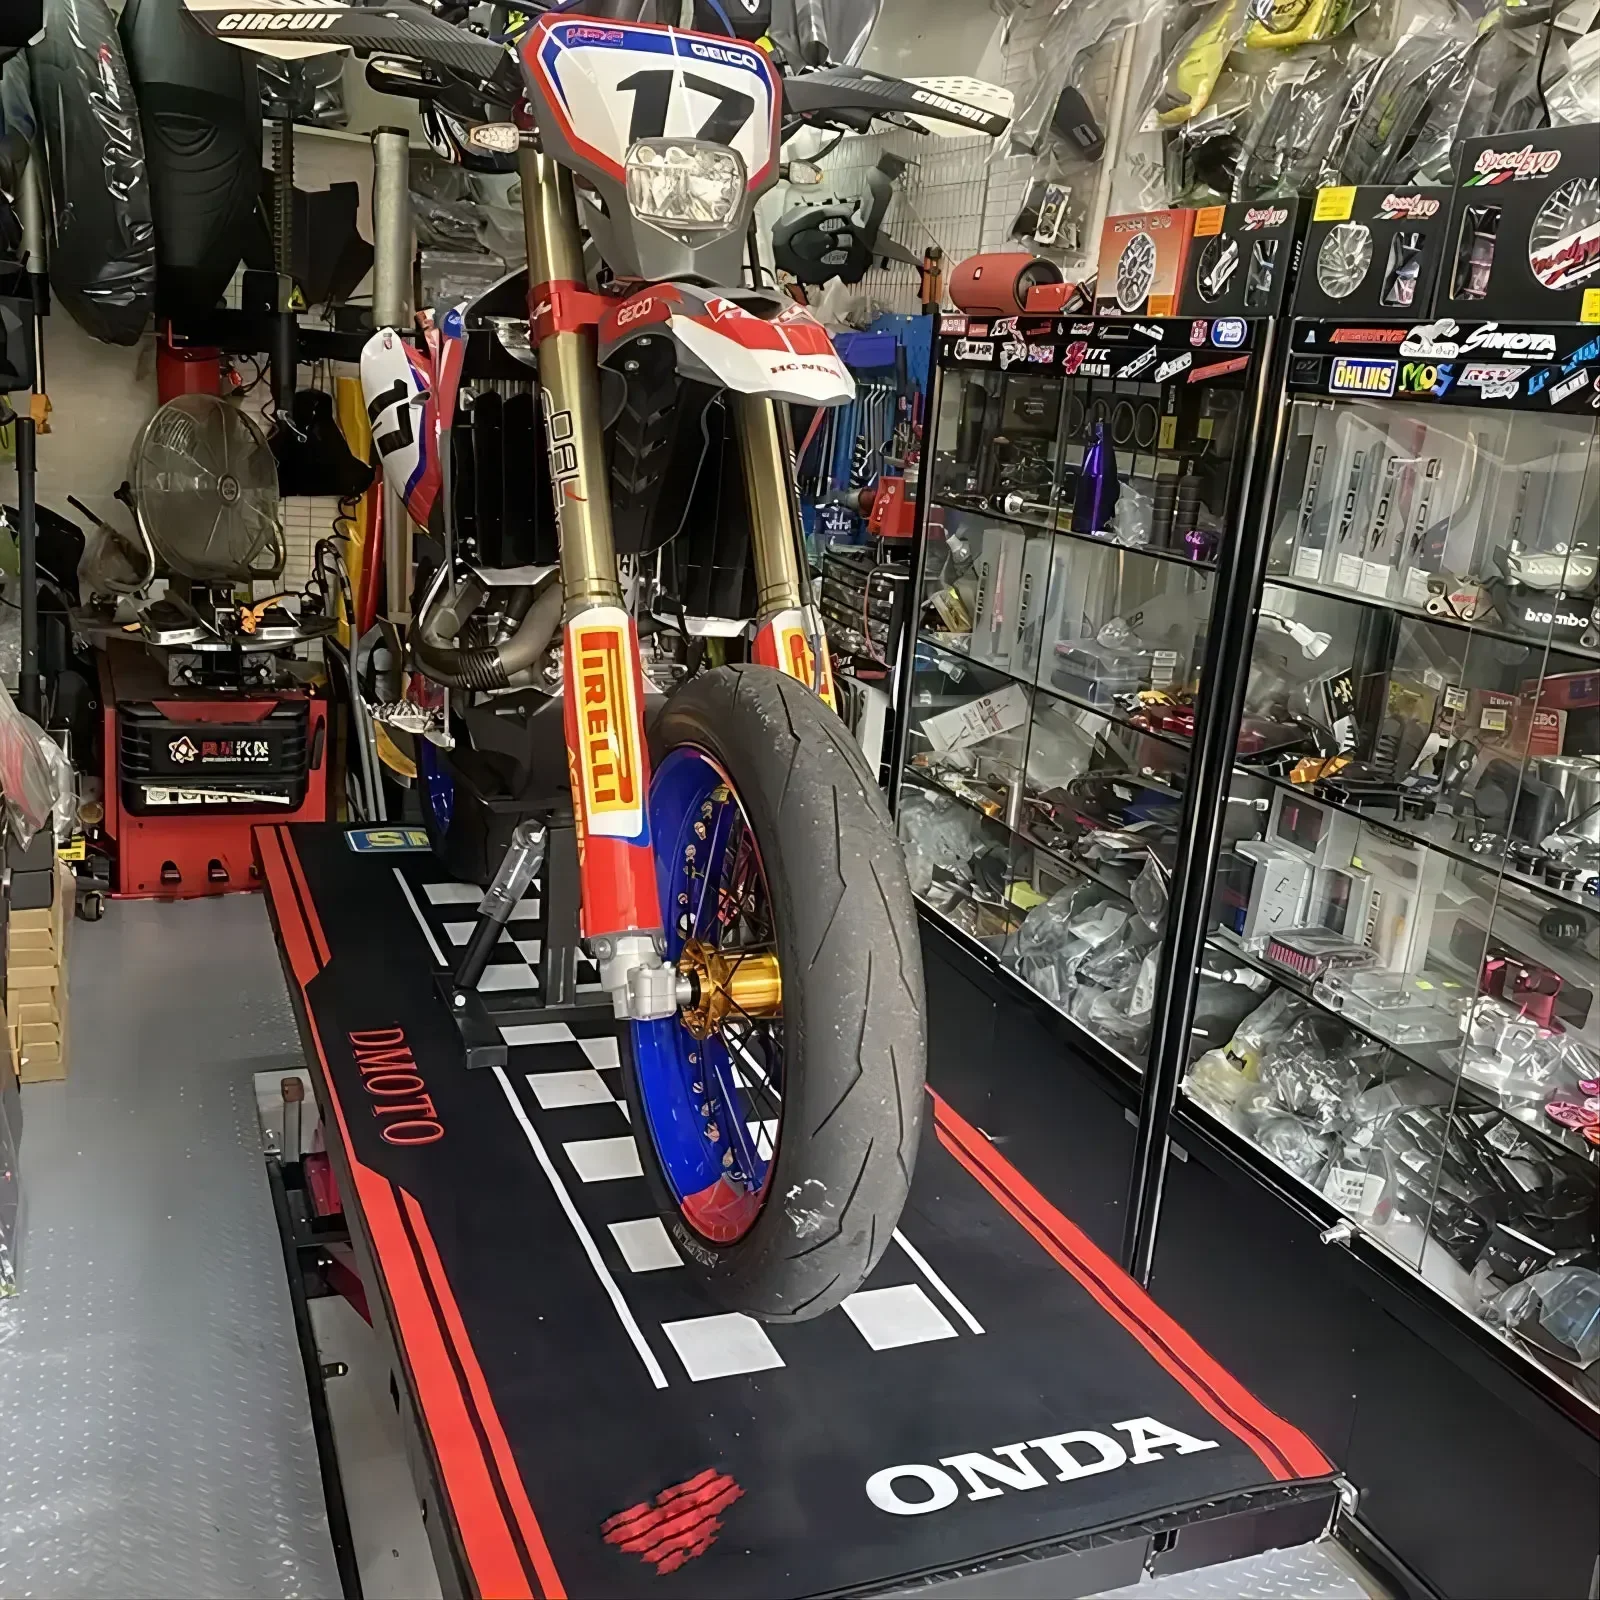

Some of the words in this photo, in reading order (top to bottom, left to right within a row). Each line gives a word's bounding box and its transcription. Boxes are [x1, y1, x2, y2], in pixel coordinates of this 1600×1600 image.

[217, 13, 343, 30] CIRCUIT
[691, 43, 758, 71] GEICO
[616, 69, 756, 146] 17
[1459, 321, 1556, 353] SIMOTA
[771, 364, 842, 380] HONDA
[580, 631, 634, 804] PIRELLI
[347, 1026, 445, 1146] DMOTO
[864, 1414, 1220, 1515] ONDA
